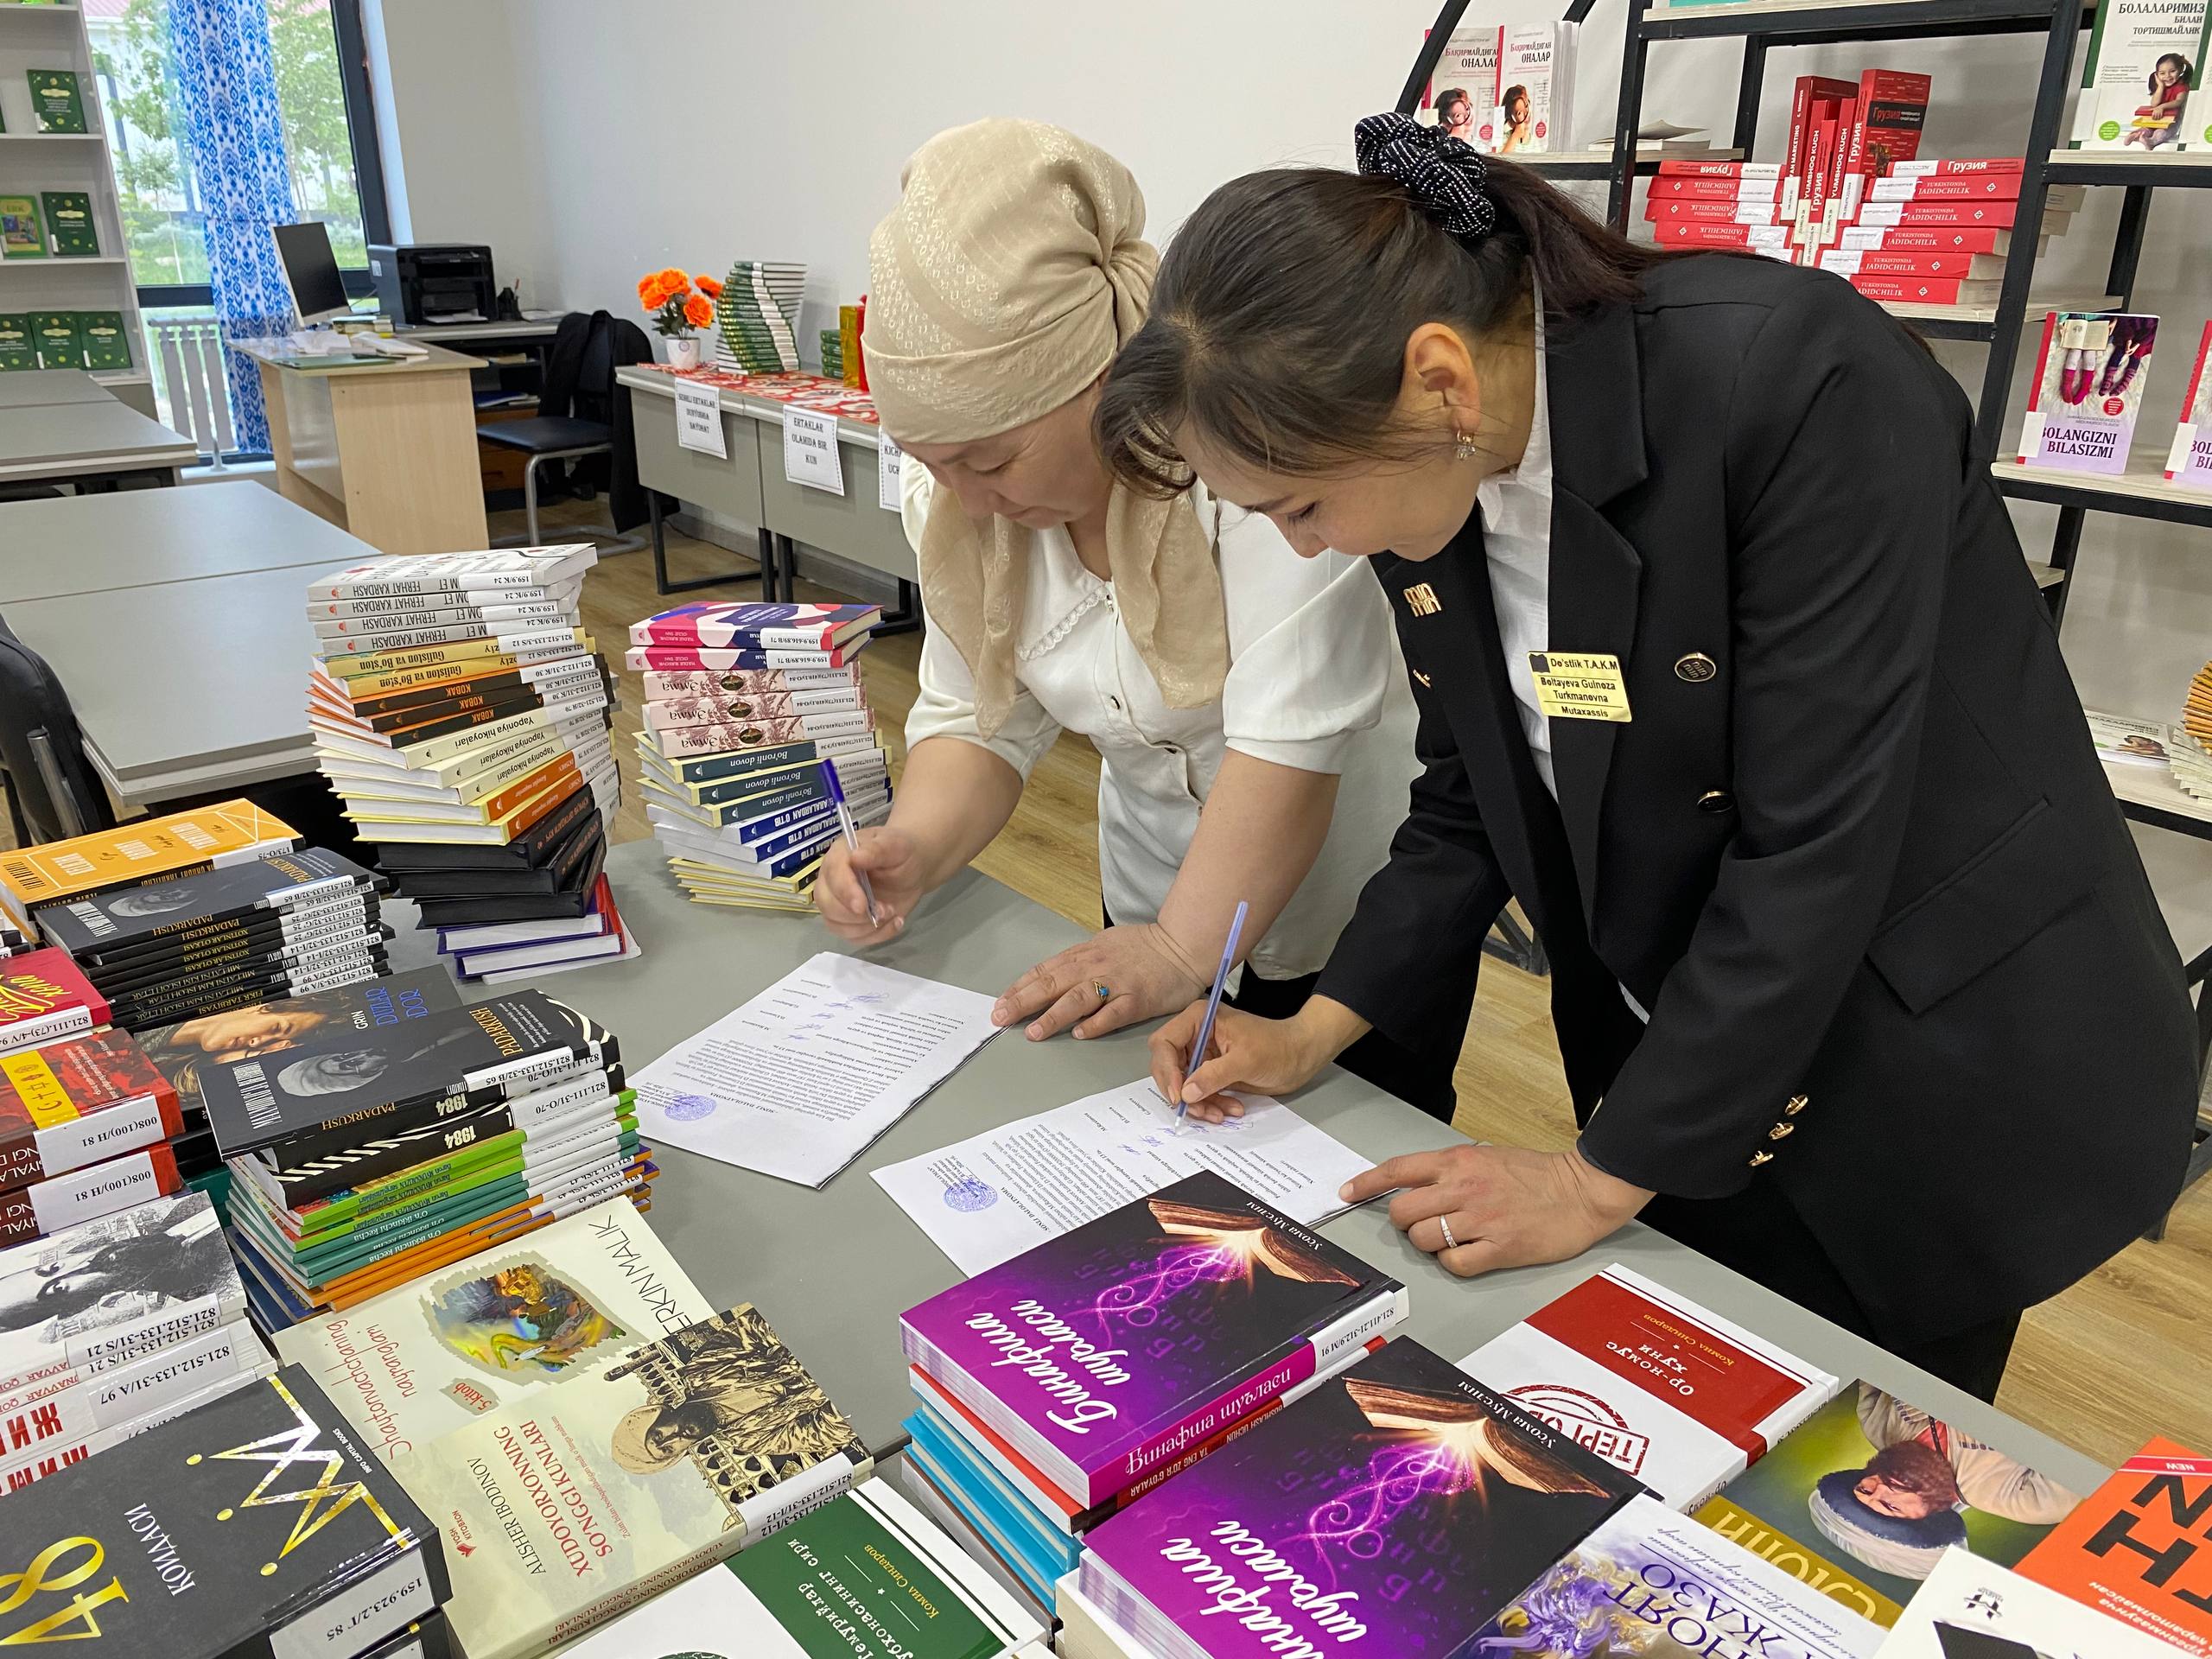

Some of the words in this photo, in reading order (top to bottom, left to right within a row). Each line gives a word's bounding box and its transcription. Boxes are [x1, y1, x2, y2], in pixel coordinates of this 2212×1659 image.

[2119, 3, 2204, 14] БОЛАЛАРИМИЗ
[2133, 25, 2201, 35] ТОРТИШМАЙЛИК
[1521, 51, 1551, 64] ОНАЛАР
[1790, 124, 1800, 168] MARKETING
[1811, 130, 1821, 154] KUCH
[1839, 128, 1847, 150] KUCH
[1847, 122, 1863, 163] Грузия
[1700, 166, 1732, 176] Грузия
[1947, 160, 1988, 172] Грузия
[1810, 172, 1823, 212] Грузия
[1918, 187, 1971, 195] JADIDCHILIK
[1906, 213, 1959, 222] JADIDCHILIK
[1886, 237, 1937, 246] JADIDCHILIK
[1865, 263, 1916, 271] JADIDCHILIK
[1857, 288, 1903, 297] ADIDCHILIK
[793, 417, 823, 433] ERTAKLAR
[791, 434, 817, 448] OLAMIDA
[817, 439, 828, 451] BIR
[2047, 441, 2114, 459] BILASIZMI
[805, 454, 817, 465] KUN
[392, 580, 422, 594] FERHAT
[504, 575, 530, 584] 159.9/K
[353, 583, 391, 598] KARDASH
[515, 589, 543, 600] 159.9/K
[352, 600, 392, 613] KARDASH
[395, 595, 425, 610] FERHAT
[528, 604, 556, 613] 159.9/K
[362, 615, 405, 630] KARDASH
[406, 612, 436, 625] FERHAT
[537, 616, 564, 626] 159.9/K
[371, 633, 413, 649] KARDASH
[416, 629, 447, 642] FERHAT
[407, 650, 445, 665] Guliston
[1550, 658, 1582, 671] Do'stlik
[1583, 658, 1618, 671] T.A.K.M
[424, 664, 462, 679] Guliston
[445, 684, 472, 696] KOBAK
[661, 681, 699, 692] Эмма
[1541, 677, 1580, 690] Boltayeva
[1581, 678, 1616, 691] Gulnoza
[458, 695, 485, 709] KOBAK
[1553, 690, 1609, 703] Turkmanovna
[471, 709, 494, 723] KOBAK
[668, 709, 707, 721] Эмма
[1560, 707, 1609, 718] Mutaxassis
[496, 716, 536, 738] Yaponiya
[454, 725, 496, 748] hikoyalari
[513, 732, 546, 753] Yaponiya
[680, 734, 719, 749] Эмма
[479, 741, 515, 767] hikoyalari
[526, 747, 556, 766] Yaponiya
[729, 756, 755, 767] dovon
[498, 758, 527, 785] hikoyalari
[745, 778, 770, 789] dovon
[761, 794, 784, 807] dovon
[152, 913, 214, 937] PADARKUSH
[181, 918, 241, 943] PADARKUSH
[236, 989, 264, 1005] FIKR
[198, 997, 237, 1015] TARBIYASI
[354, 1009, 369, 1031] GRIN
[467, 1006, 524, 1058] PADARKUSH
[495, 1052, 571, 1084] 821.512.133-32/B
[435, 1094, 469, 1116] 1984
[534, 1081, 607, 1116] 821.111-31/O-70
[320, 1101, 397, 1131] PADARKUSH
[81, 1135, 95, 1147] 81
[442, 1124, 478, 1149] 1984
[75, 1190, 90, 1203] 81
[376, 1213, 411, 1235] ikkinchi
[353, 1225, 377, 1242] kecha
[391, 1234, 424, 1255] ikkinchi
[588, 1214, 650, 1278] MALIK
[368, 1246, 391, 1263] kecha
[630, 1270, 695, 1336] ERKIN
[106, 1306, 217, 1354] 821.512.133-31/S
[86, 1345, 105, 1358] 21
[119, 1344, 231, 1398] 821.512.133-31/A
[963, 1311, 1119, 1436] Бинафша
[1605, 1340, 1695, 1397] Ор-номус
[100, 1390, 119, 1406] 97
[451, 1381, 490, 1415] 5-kitob
[1123, 1412, 1215, 1478] Бинафша
[1218, 1365, 1293, 1426] шуъласи
[332, 1427, 346, 1445] BOOKS
[518, 1420, 575, 1487] KUNLARI
[1182, 1452, 1200, 1467] ENG
[2165, 1462, 2196, 1471] NEW
[467, 1456, 518, 1519] IBODINOV
[494, 1426, 589, 1579] XUDOYORXONNING
[124, 1502, 197, 1597] ҚОИДАСИ
[506, 1511, 547, 1576] ALISHER
[787, 1538, 820, 1567] сири
[1638, 1560, 1786, 1656] ЖАЗО
